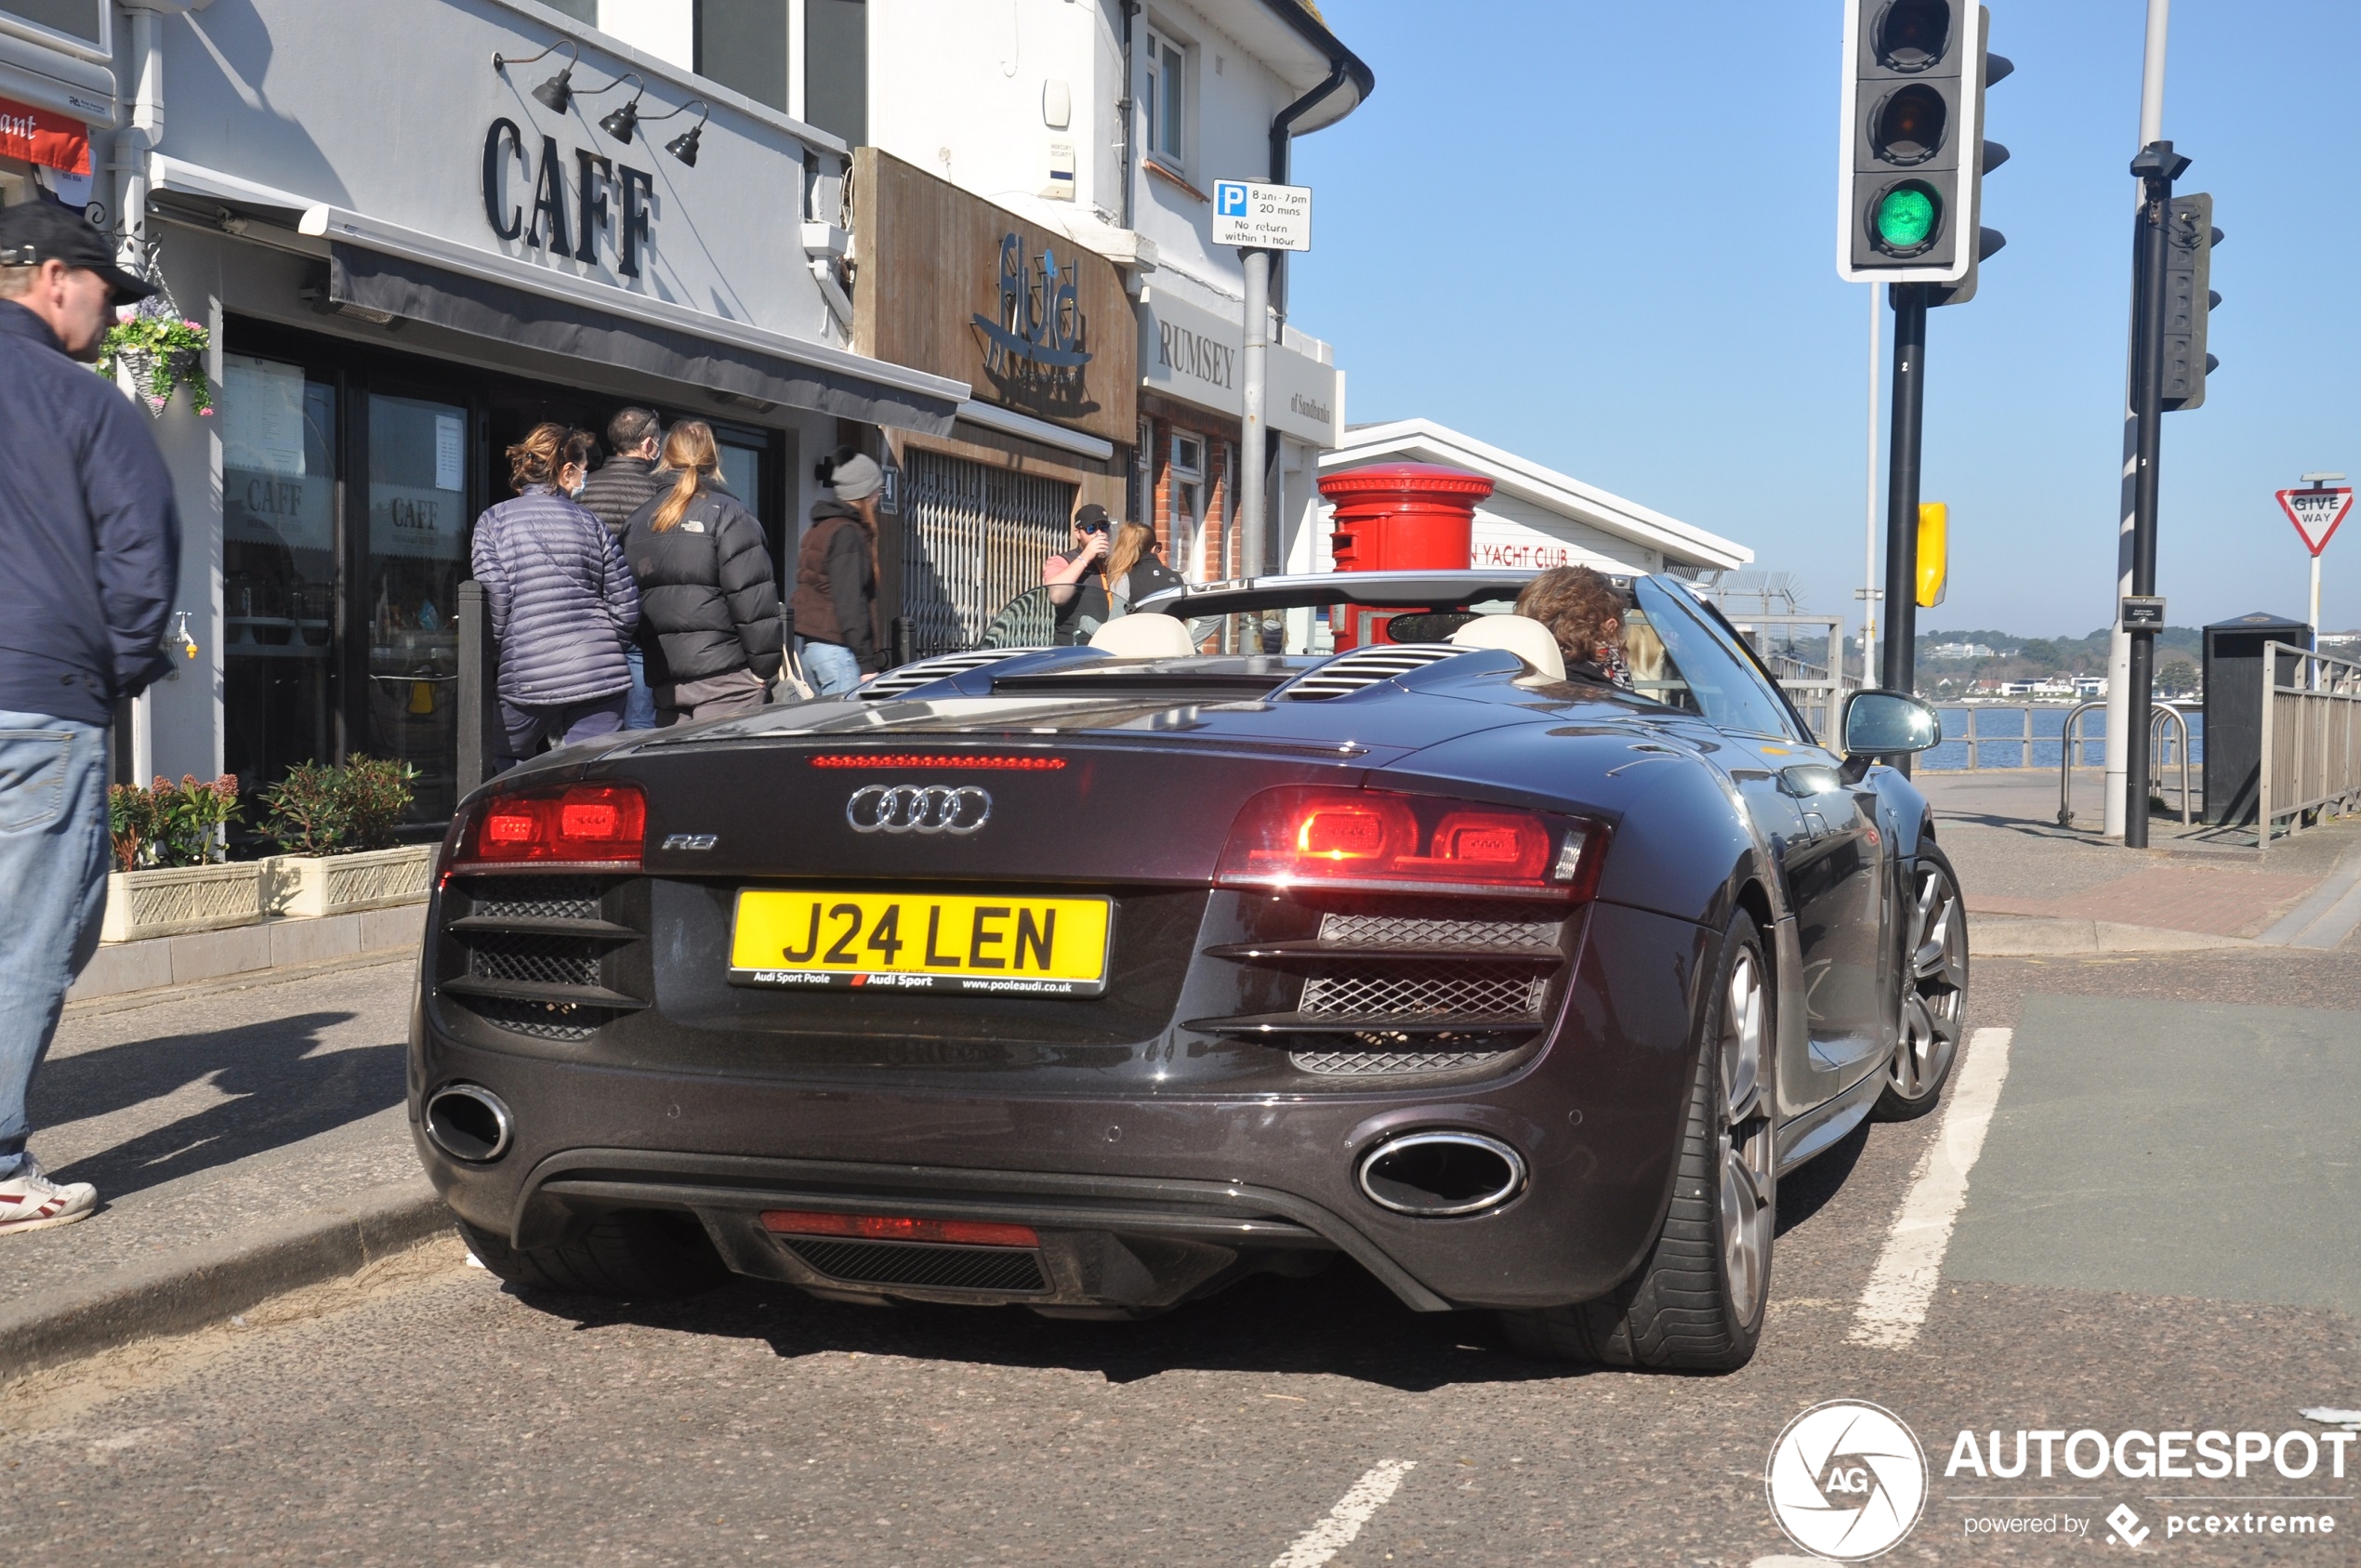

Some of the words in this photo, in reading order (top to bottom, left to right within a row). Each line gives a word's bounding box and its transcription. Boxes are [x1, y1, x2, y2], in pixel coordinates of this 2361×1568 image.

[482, 117, 653, 279] CAFF
[1260, 204, 1274, 214] 20
[1277, 207, 1301, 217] mins
[1234, 220, 1249, 230] No
[1256, 222, 1287, 233] return
[1225, 231, 1257, 243] within
[1273, 236, 1296, 245] hour
[1159, 319, 1235, 390] RUMSEY
[1901, 362, 1908, 372] 2
[1290, 392, 1299, 414] of
[1299, 393, 1331, 425] Sandbanks
[885, 473, 892, 499] 4
[246, 478, 302, 516] CAFF
[2294, 496, 2340, 511] GIVE
[391, 496, 439, 530] CAFF
[2302, 513, 2331, 522] WAY
[1483, 544, 1530, 567] YACHT
[1535, 547, 1568, 568] CLUB
[661, 834, 717, 850] R8
[782, 903, 904, 966] J24
[924, 904, 1056, 971] LEN
[754, 971, 776, 982] Audi
[776, 973, 802, 984] Sport
[803, 972, 831, 984] Poole
[866, 973, 896, 986] Audi
[898, 975, 933, 988] Sport
[962, 979, 1073, 993] www.pooleaudi.co.uk
